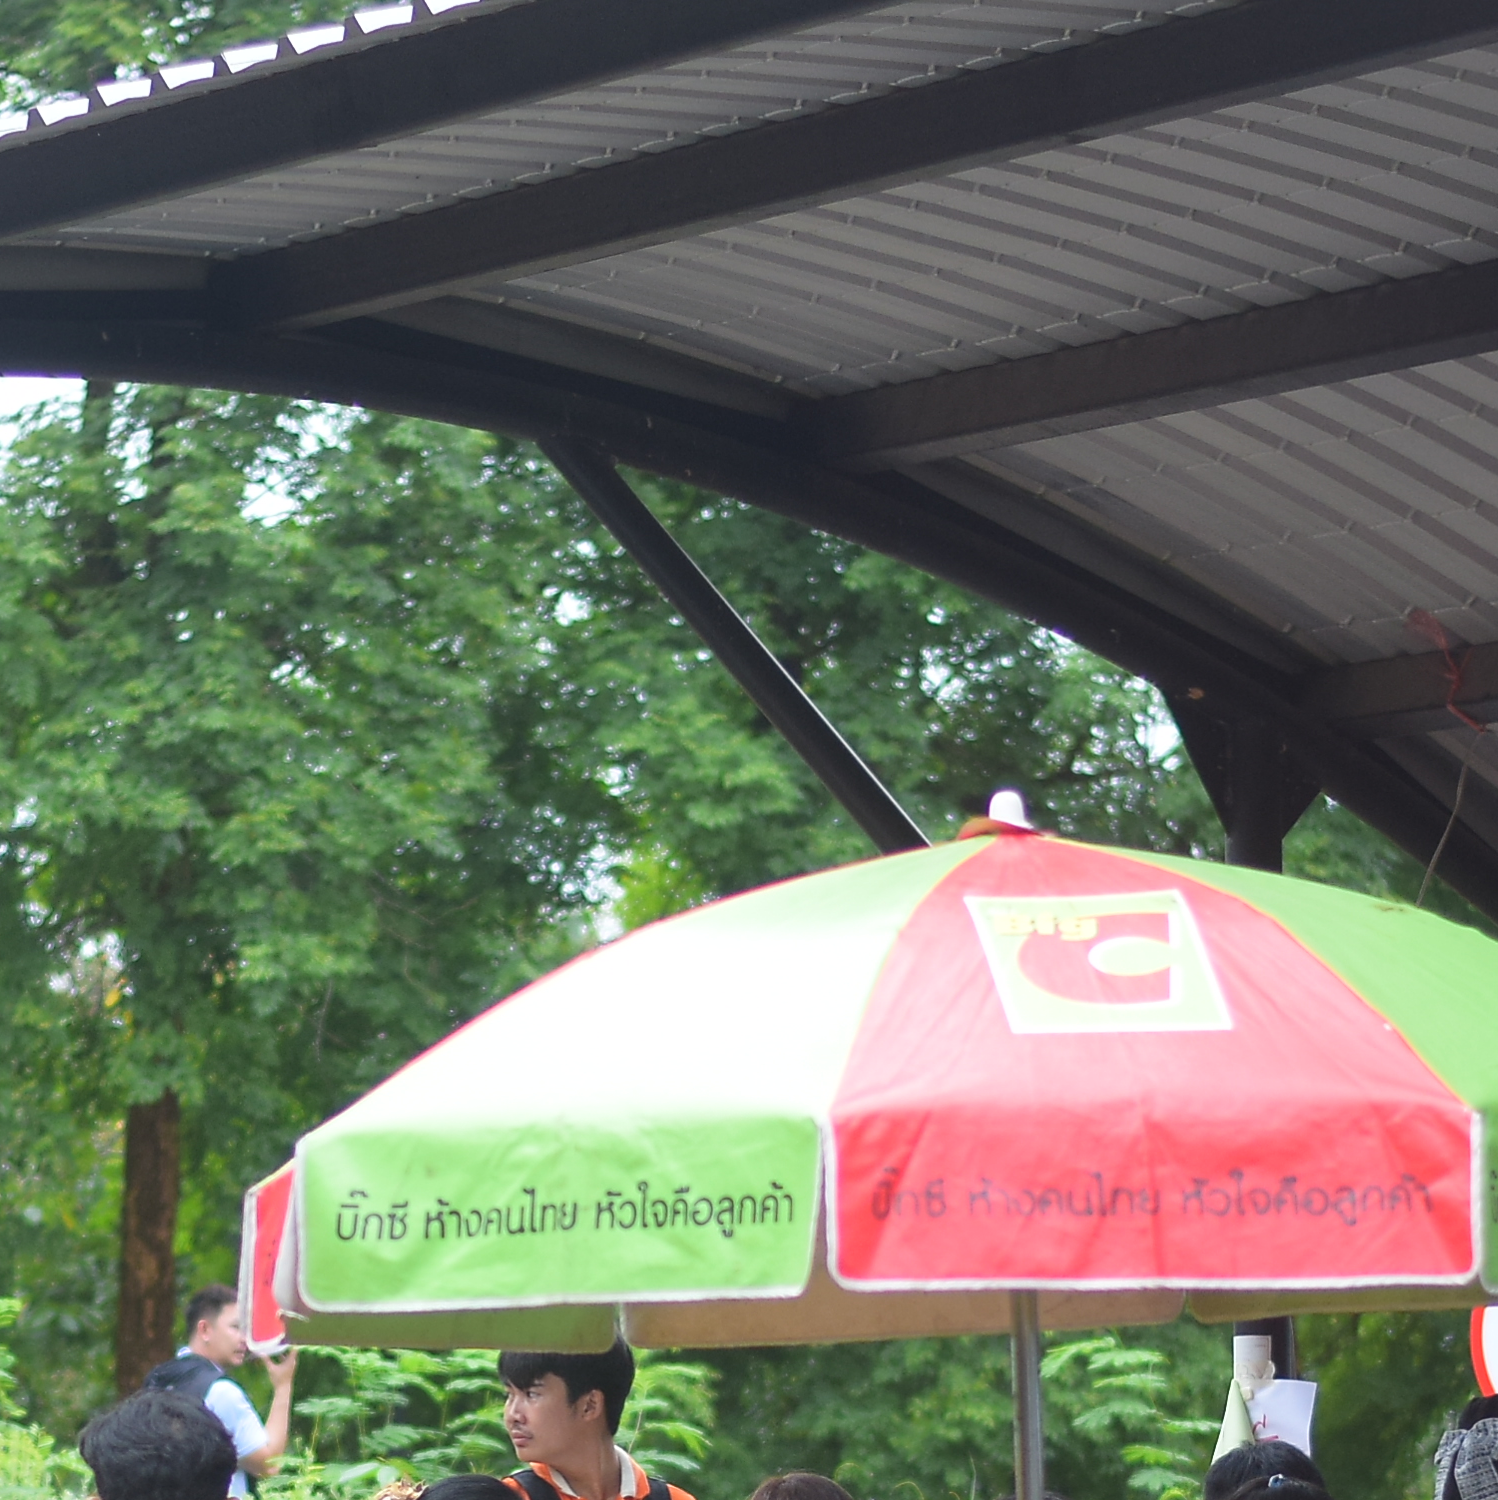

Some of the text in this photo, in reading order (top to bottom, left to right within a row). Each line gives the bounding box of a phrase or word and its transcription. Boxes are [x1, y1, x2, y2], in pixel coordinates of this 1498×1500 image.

[336, 1181, 793, 1241] บิ๊กซี ห้างคนไทย หัวใจคือลูกค้า
[969, 1173, 1159, 1217] ห้างคนไทย
[1182, 1168, 1432, 1227] หัวใจคือลูกค้า
